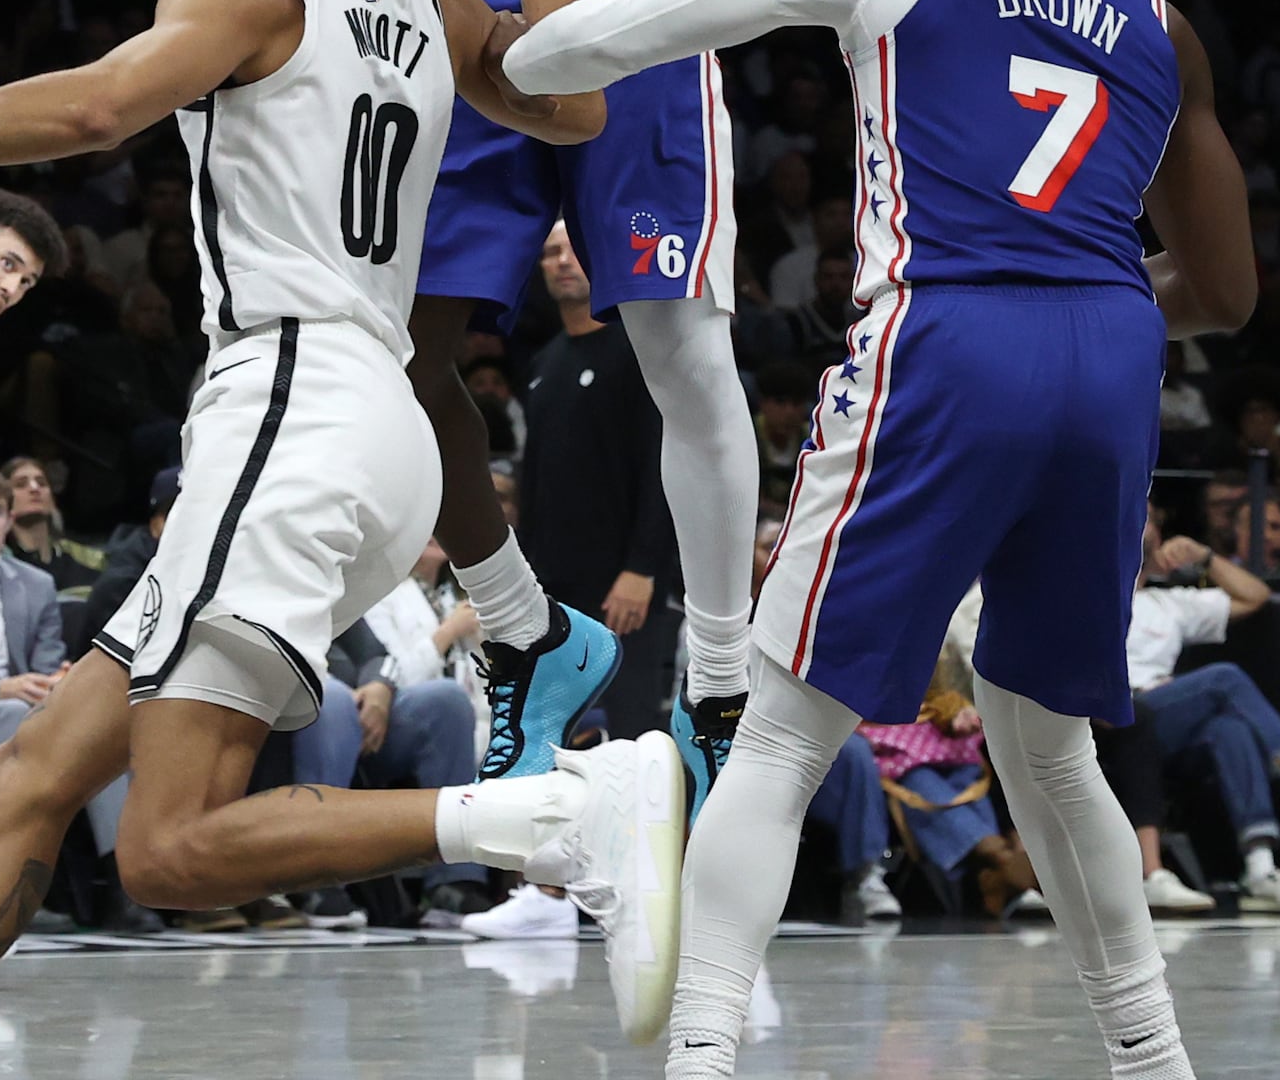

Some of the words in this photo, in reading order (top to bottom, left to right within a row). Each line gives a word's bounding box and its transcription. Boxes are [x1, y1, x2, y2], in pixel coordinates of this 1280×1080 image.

[340, 93, 418, 264] 00
[1008, 54, 1109, 212] 7
[630, 233, 686, 279] 76
